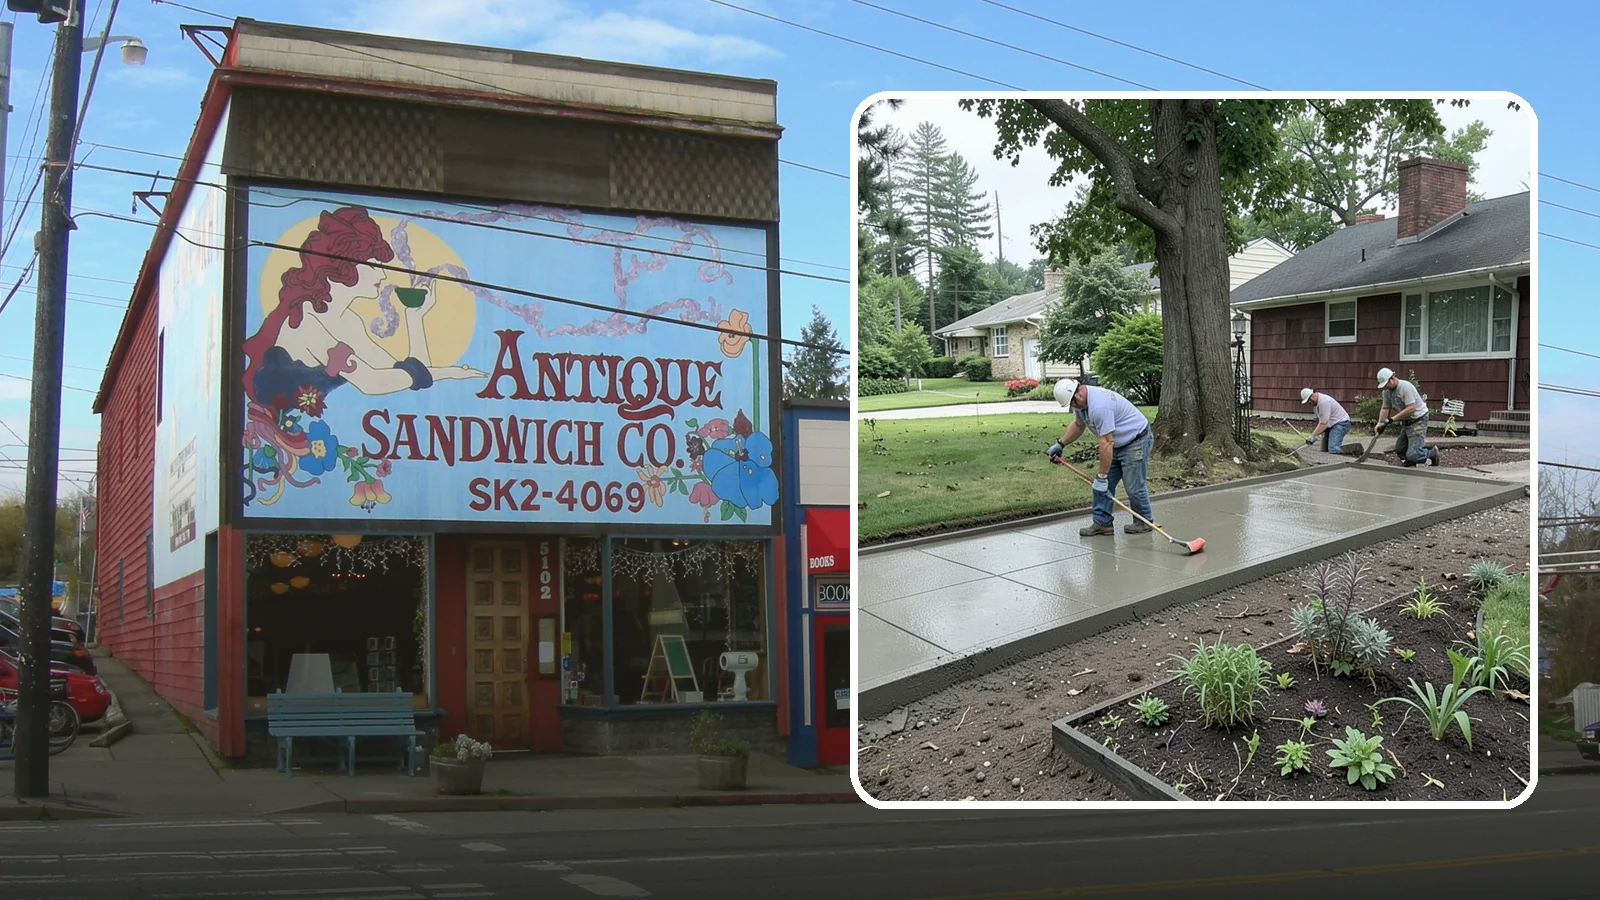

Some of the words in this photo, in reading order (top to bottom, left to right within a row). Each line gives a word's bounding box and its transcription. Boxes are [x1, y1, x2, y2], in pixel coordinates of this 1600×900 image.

[476, 329, 724, 421] ANTIQUE
[361, 408, 605, 468] SANDWICH
[616, 419, 685, 469] CO.
[468, 476, 646, 513] SK2-4069
[540, 541, 551, 599] 5102
[809, 555, 835, 569] BOOKS
